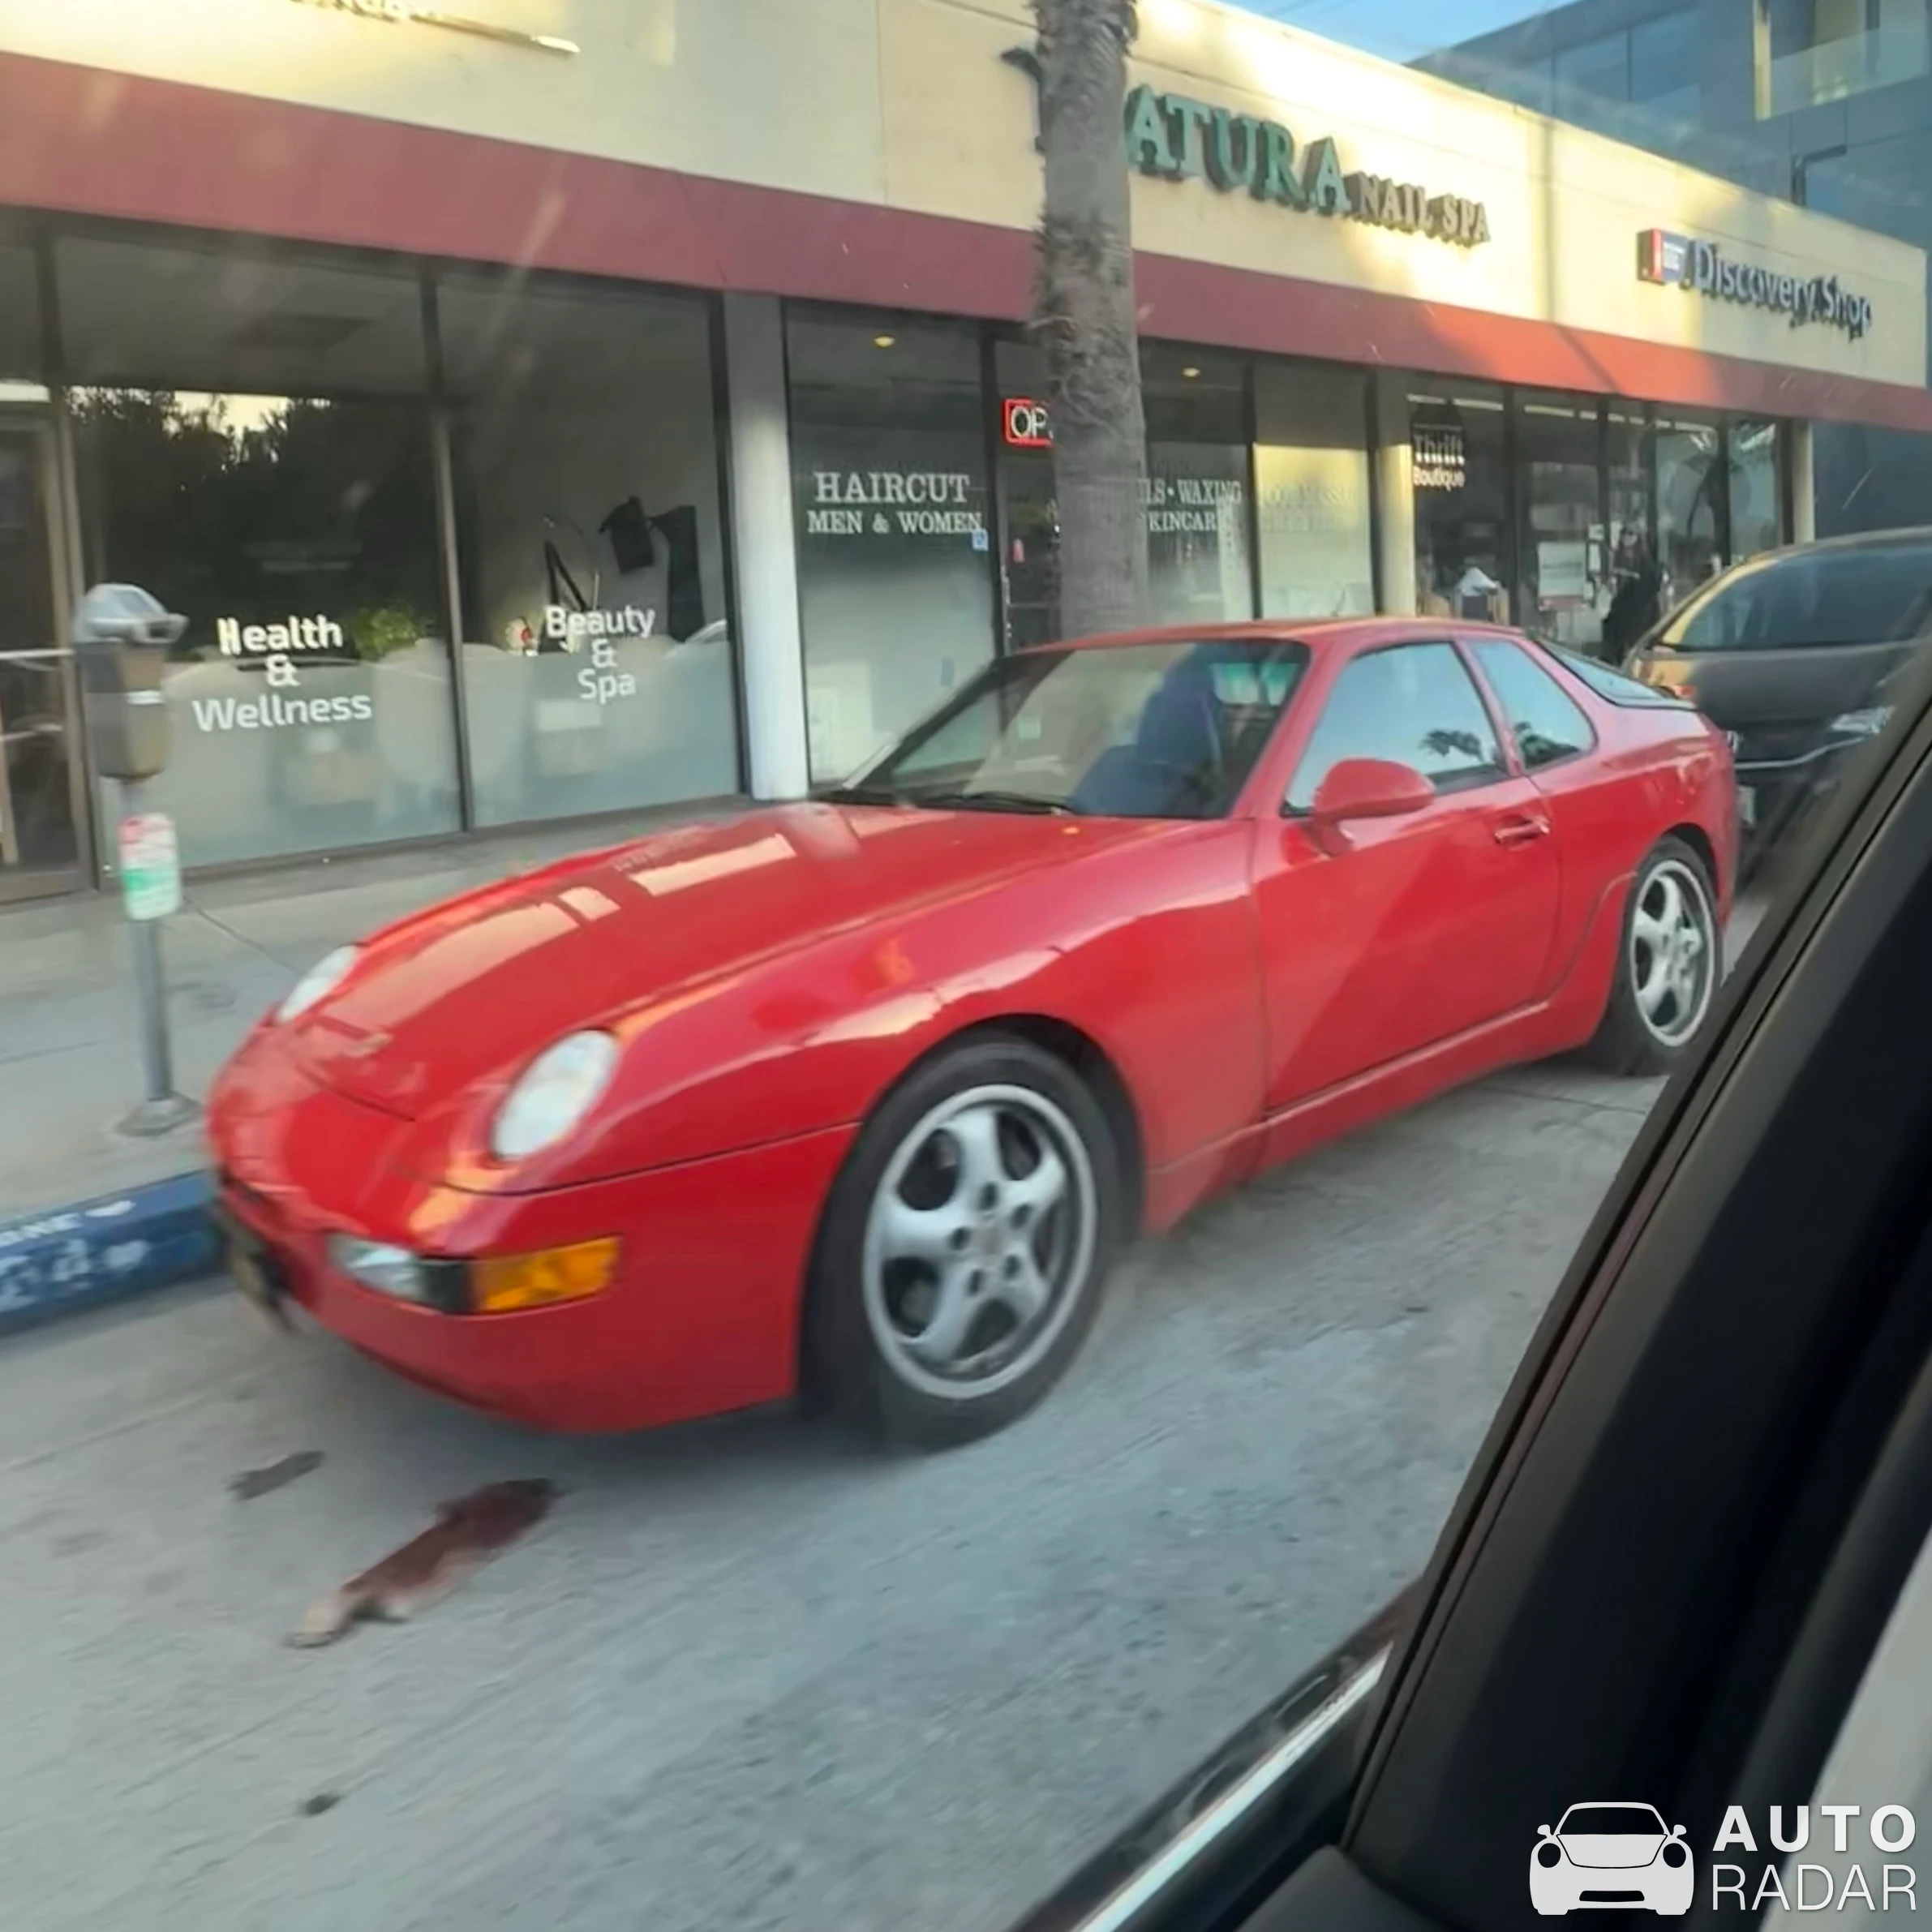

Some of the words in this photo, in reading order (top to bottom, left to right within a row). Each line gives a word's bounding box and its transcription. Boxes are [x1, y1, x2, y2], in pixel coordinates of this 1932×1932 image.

[1123, 84, 1351, 216] ATURA
[1355, 171, 1435, 232] NAIL
[1440, 193, 1491, 246] SPA
[1691, 239, 1817, 321] Discovery
[1822, 276, 1873, 334] Shop
[1011, 406, 1054, 439] OP
[814, 471, 970, 504] HAIRCUT
[1176, 478, 1243, 504] WAXING
[807, 510, 863, 535] MEN
[872, 512, 890, 534] &
[896, 510, 983, 535] WOMEN
[1140, 510, 1221, 533] KINCAR
[216, 614, 343, 655] Health
[545, 604, 655, 639] Beauty
[266, 653, 300, 687] &
[591, 638, 618, 668] &
[577, 668, 636, 704] Spa
[191, 693, 372, 732] Wellness
